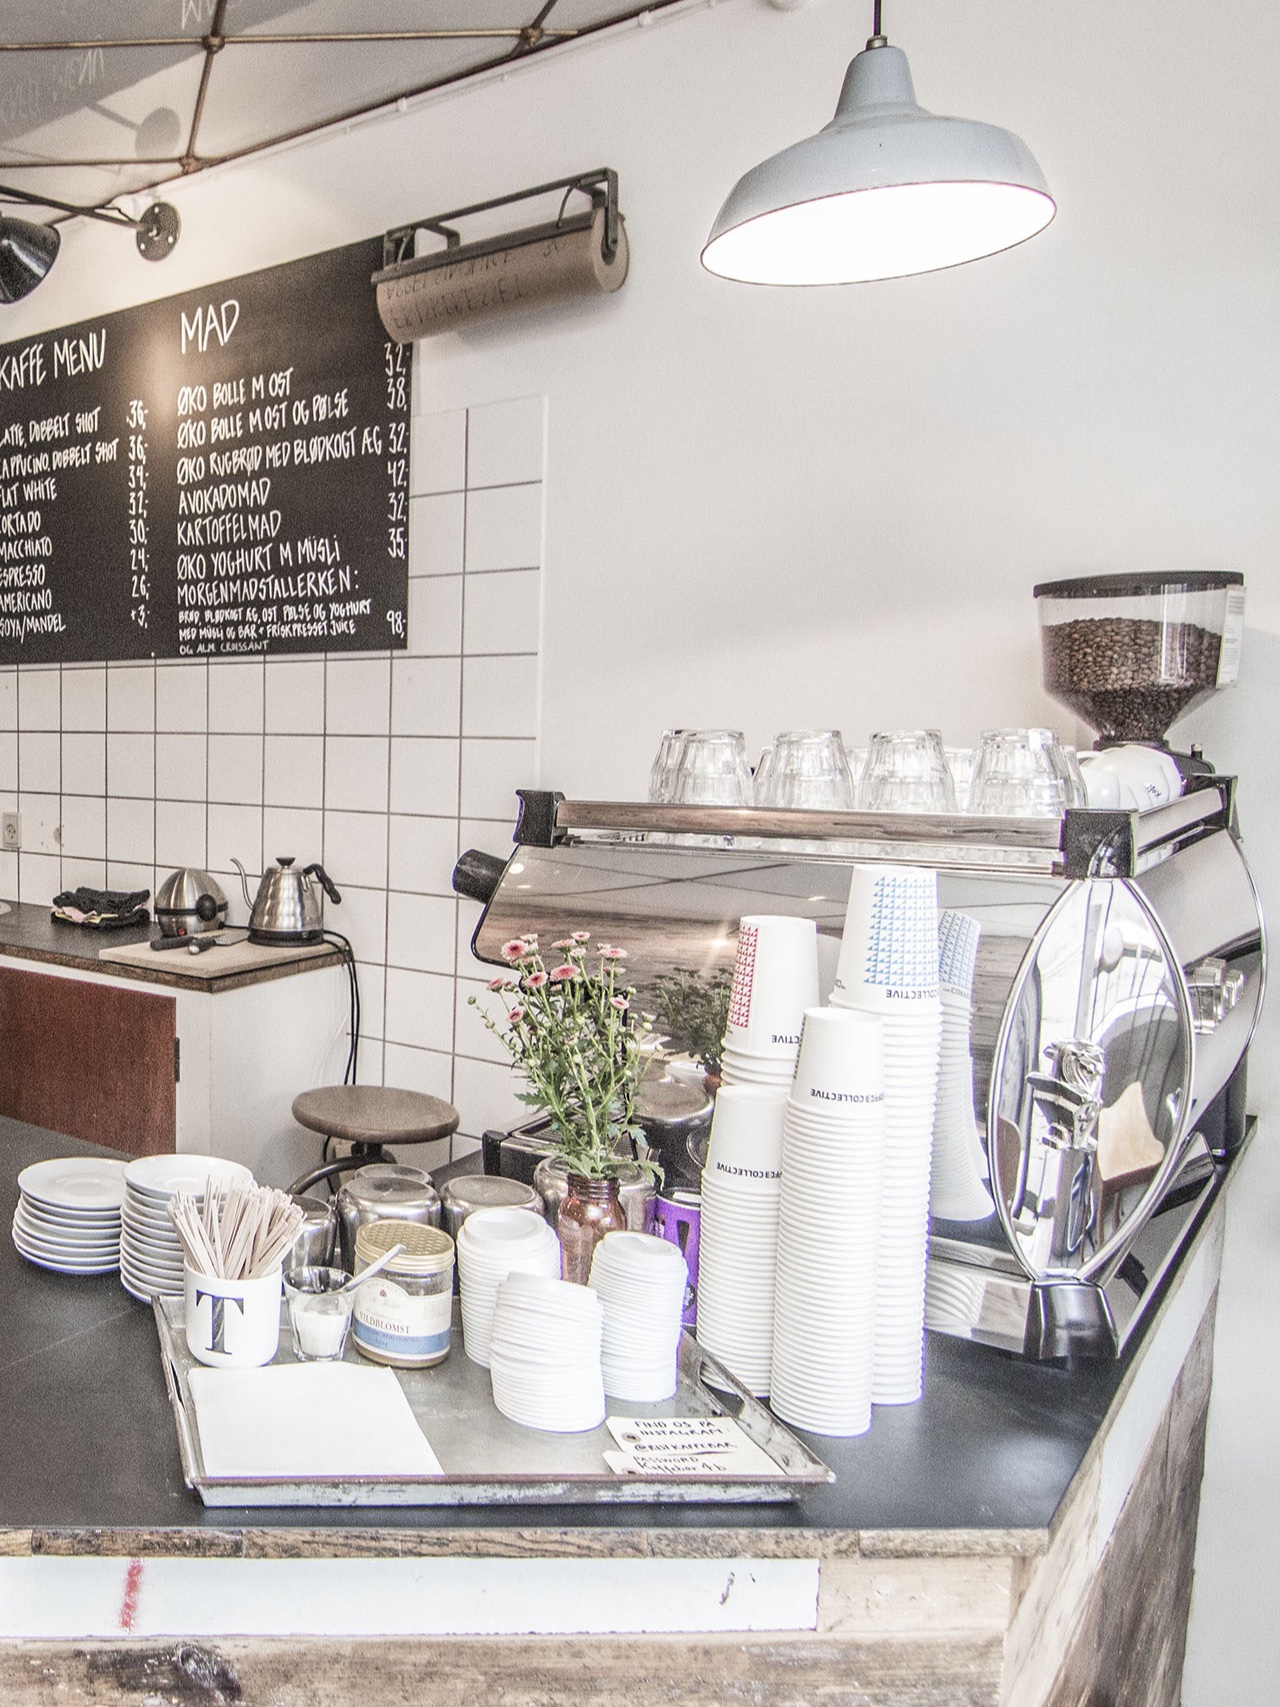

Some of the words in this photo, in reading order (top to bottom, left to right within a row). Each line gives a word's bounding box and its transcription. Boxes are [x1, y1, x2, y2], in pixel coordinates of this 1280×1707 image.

[181, 299, 240, 354] MAD
[54, 328, 107, 379] MENU
[177, 385, 207, 416] ØKO
[212, 378, 246, 410] BOLLE
[252, 374, 264, 400] M
[268, 367, 294, 398] OST
[29, 412, 70, 443] DOBBELT
[75, 406, 101, 434] SHOT
[177, 419, 206, 449] ØKO
[210, 412, 243, 444] BOLLE
[249, 408, 263, 433] M
[264, 401, 288, 431] OST
[292, 400, 310, 425] OG
[312, 388, 349, 423] PØLSE
[52, 442, 92, 471] DOBBELT
[95, 437, 119, 464] SHOT
[177, 456, 205, 486] ØKO
[209, 445, 263, 477] RUGBRØD
[266, 441, 291, 469] MED
[293, 426, 357, 466] BLØDKOGT
[361, 425, 382, 456] ÆG
[178, 477, 271, 515] AVOKADOMAD
[177, 509, 282, 546] KARTOFFELMAD
[177, 553, 206, 581] ØKO
[211, 543, 273, 577] YOGHURT
[280, 541, 293, 567] M
[313, 602, 327, 620] OG
[329, 598, 372, 618] YOGHURT
[179, 627, 196, 641] MED
[225, 625, 236, 639] OG
[179, 645, 194, 655] OG
[220, 639, 270, 653] CROISSANT
[810, 1088, 865, 1103] COLLECTIVE
[716, 1162, 765, 1179] COLLECTIVE
[196, 1289, 244, 1355] T
[673, 1420, 691, 1428] OS
